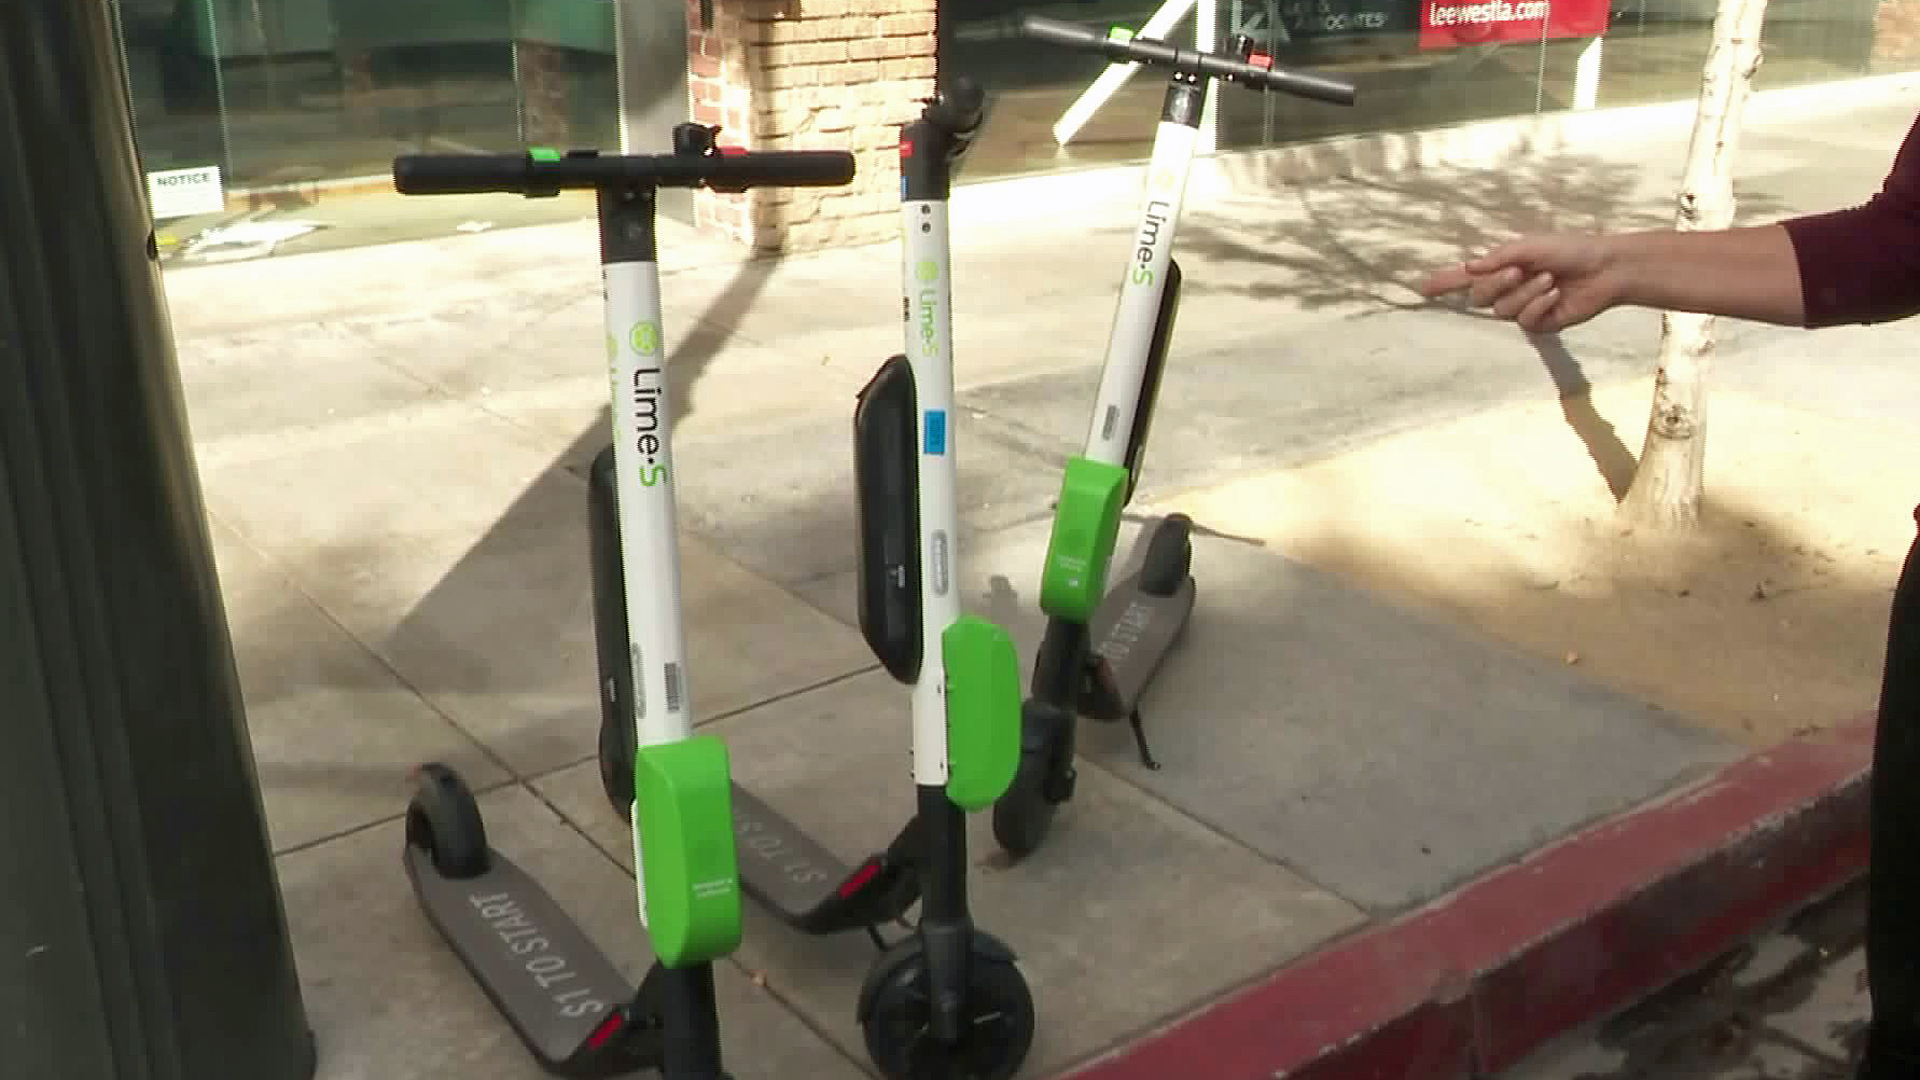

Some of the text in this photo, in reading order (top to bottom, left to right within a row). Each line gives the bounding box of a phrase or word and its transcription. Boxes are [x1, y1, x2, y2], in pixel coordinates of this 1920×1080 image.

[1429, 1, 1548, 26] leewestla.com
[156, 172, 210, 187] NOTICE
[468, 891, 605, 1018] $1 TO START
